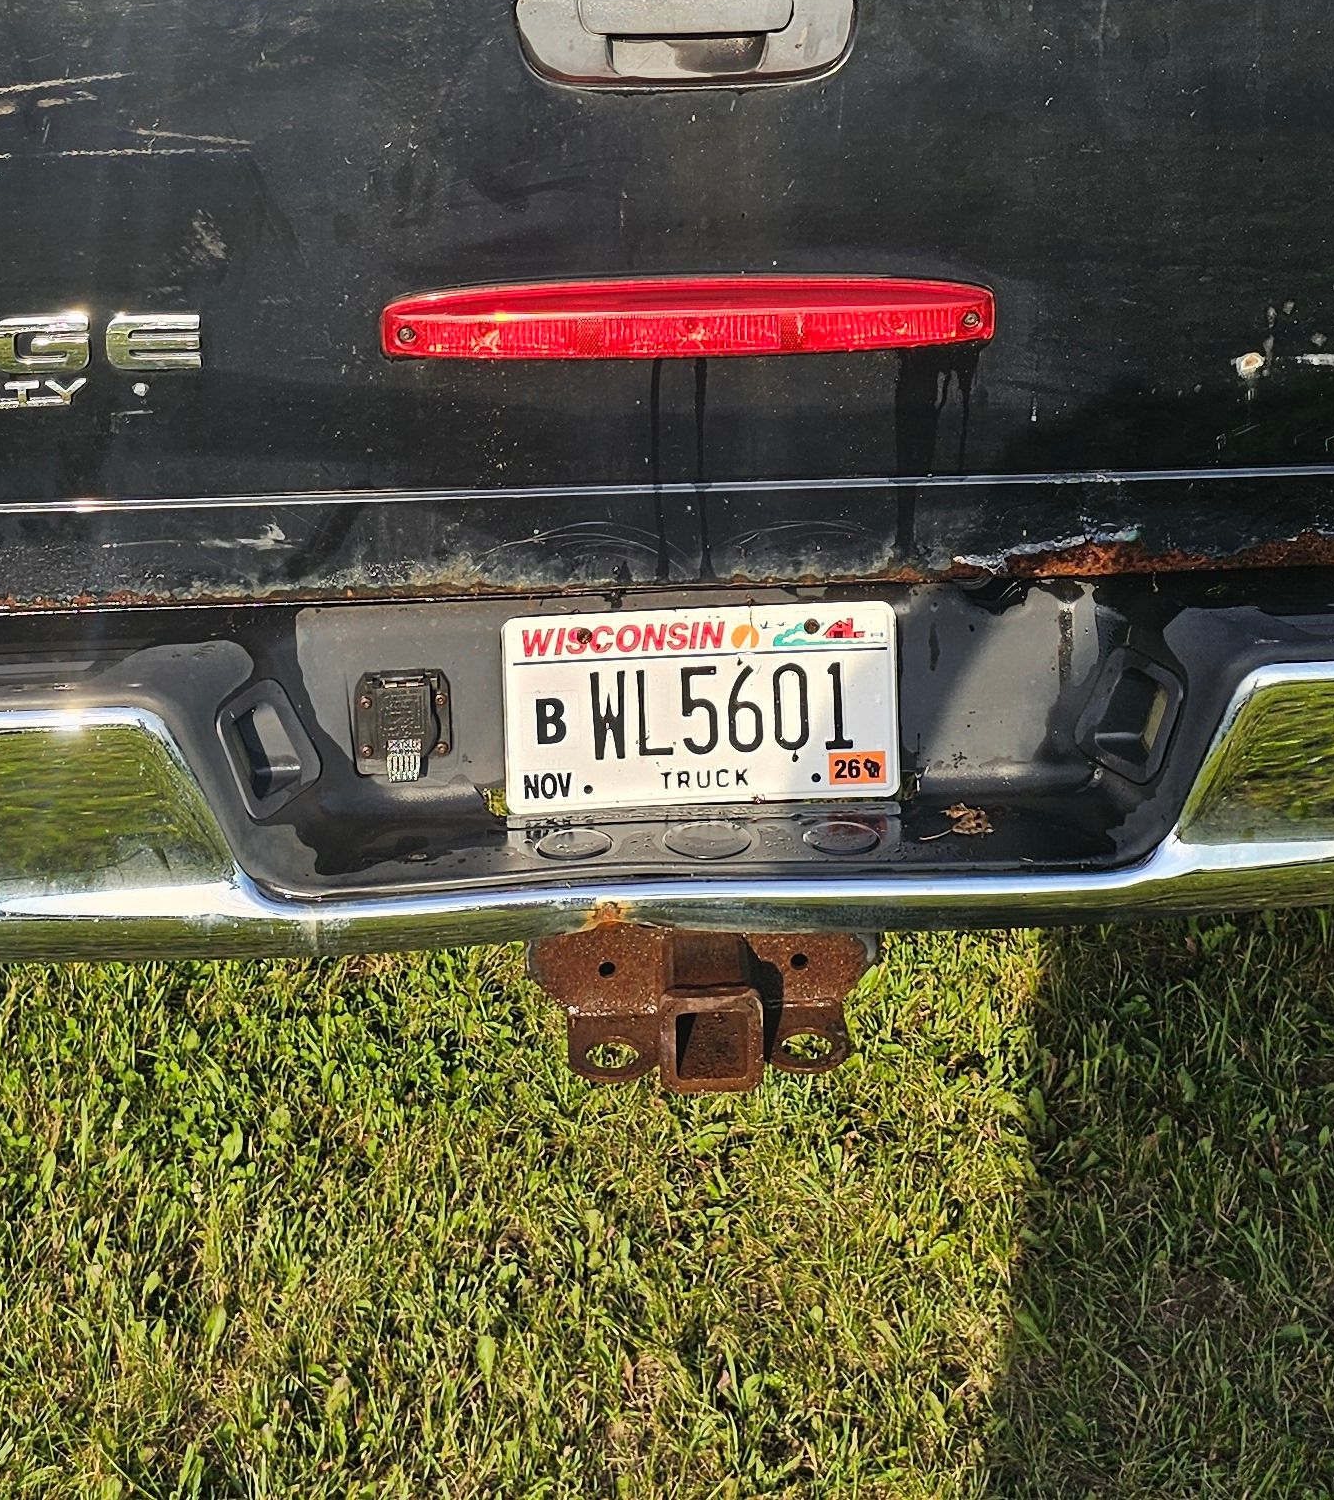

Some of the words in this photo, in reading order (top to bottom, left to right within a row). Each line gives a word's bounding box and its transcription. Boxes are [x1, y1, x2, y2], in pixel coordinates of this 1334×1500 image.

[522, 620, 726, 657] WISCONSIN
[536, 697, 568, 745] B
[589, 661, 855, 760] WL5601
[661, 767, 749, 790] TRUCK
[834, 758, 861, 779] 26
[523, 771, 572, 800] NOV
